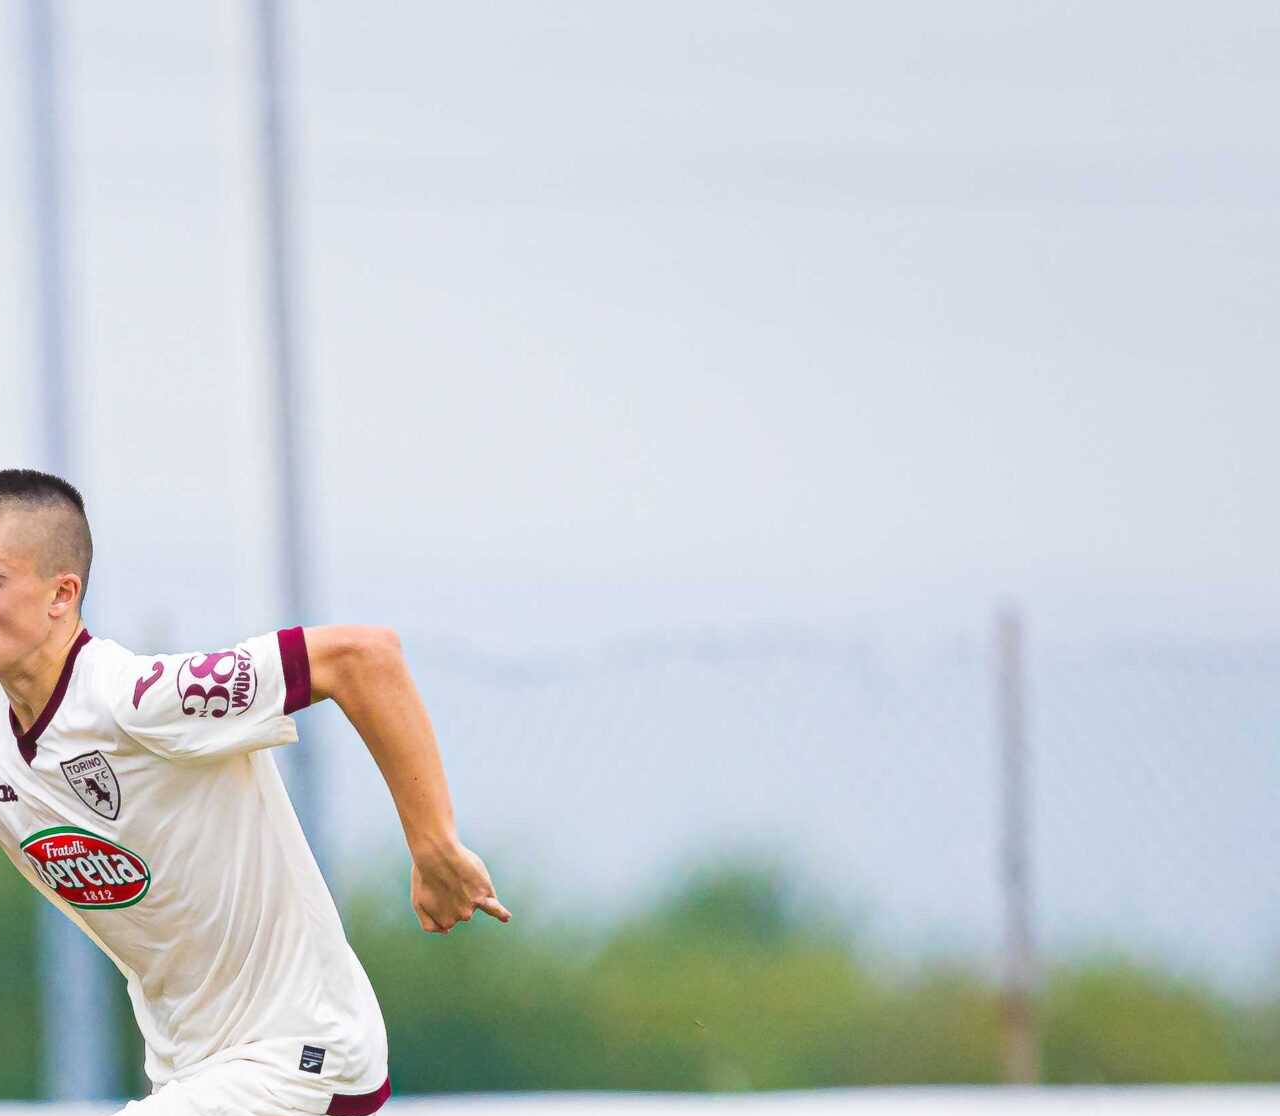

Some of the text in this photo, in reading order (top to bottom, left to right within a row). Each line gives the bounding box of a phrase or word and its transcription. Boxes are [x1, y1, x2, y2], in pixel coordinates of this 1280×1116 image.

[182, 651, 237, 718] 38
[232, 654, 251, 708] Wüber
[66, 757, 101, 775] TORINO
[41, 840, 87, 859] Fratelli
[27, 849, 145, 889] Beretta
[83, 889, 114, 901] 1812
